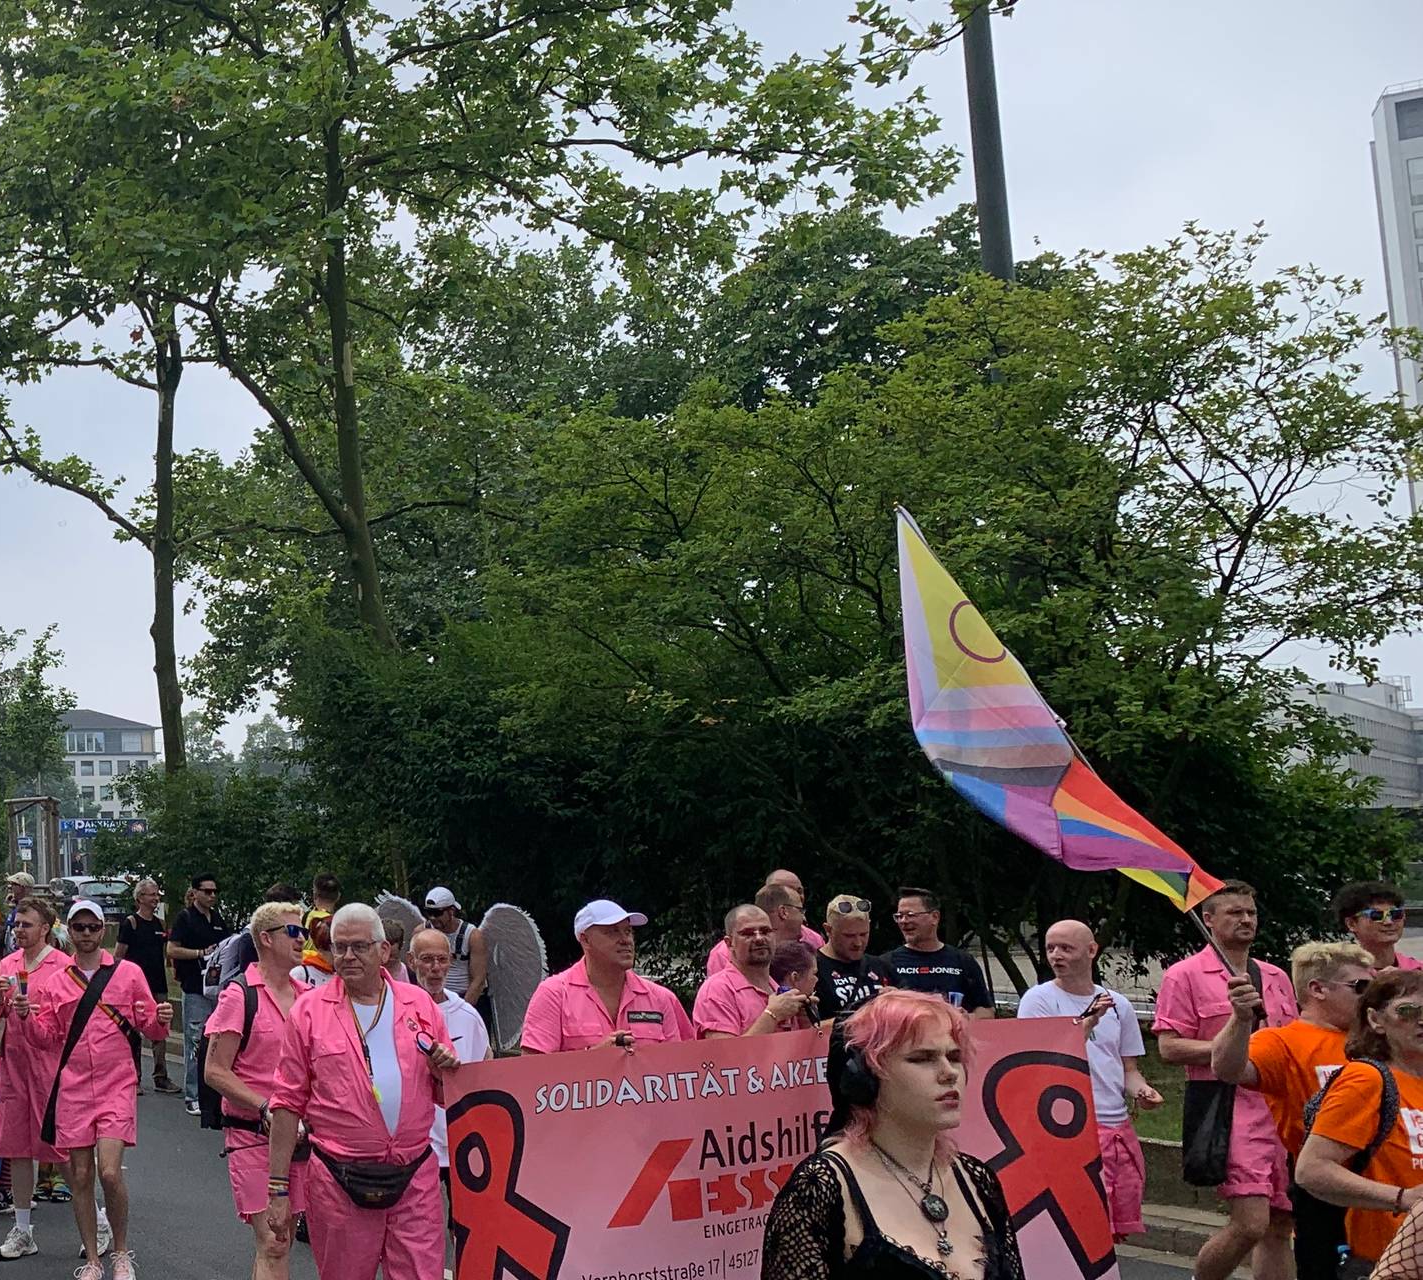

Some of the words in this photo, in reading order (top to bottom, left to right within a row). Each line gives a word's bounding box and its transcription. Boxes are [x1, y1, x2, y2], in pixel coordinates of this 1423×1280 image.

[929, 967, 961, 976] JONES
[534, 1061, 740, 1115] SOLIDARITÄT
[746, 1065, 765, 1095] &
[581, 1261, 706, 1280] horststraße
[707, 1257, 721, 1276] 17
[728, 1248, 760, 1271] 45127
